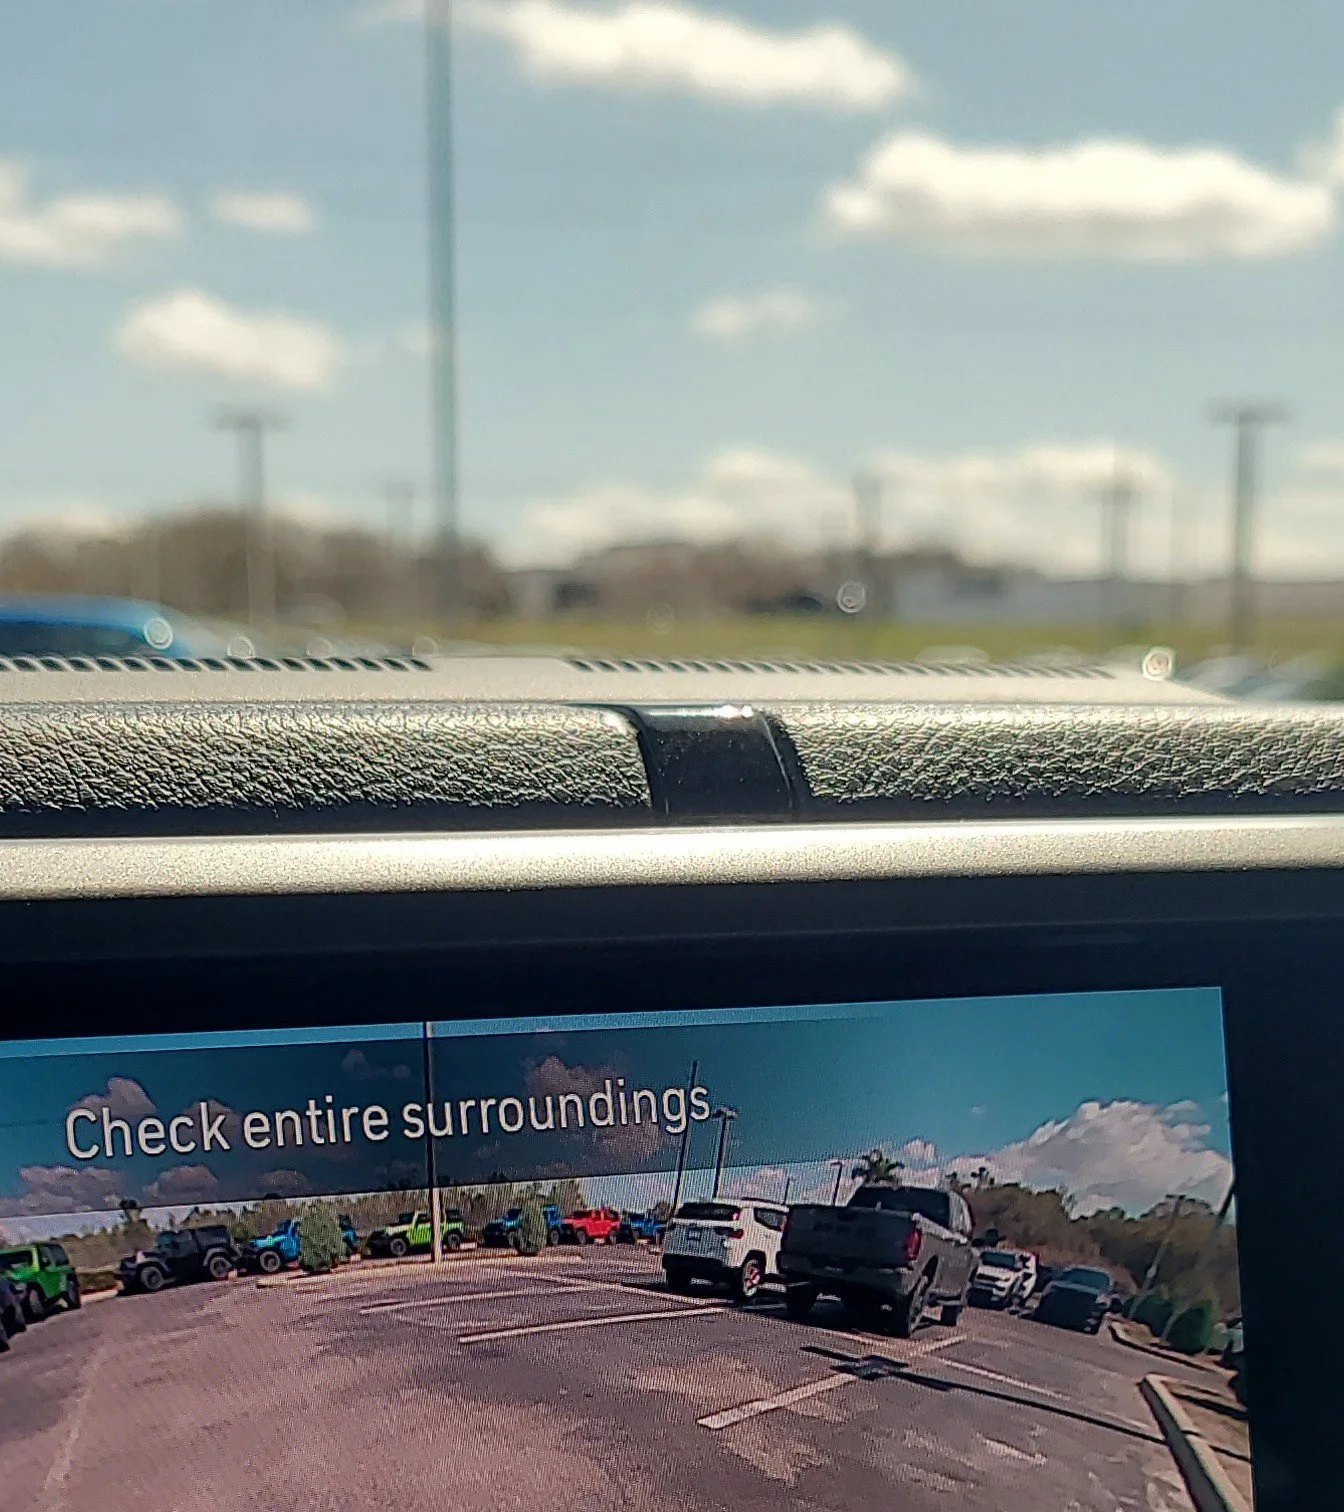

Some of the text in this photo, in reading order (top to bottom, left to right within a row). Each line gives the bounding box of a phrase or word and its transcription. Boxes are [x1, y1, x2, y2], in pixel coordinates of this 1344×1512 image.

[64, 1079, 711, 1160] Check entire surroundings
